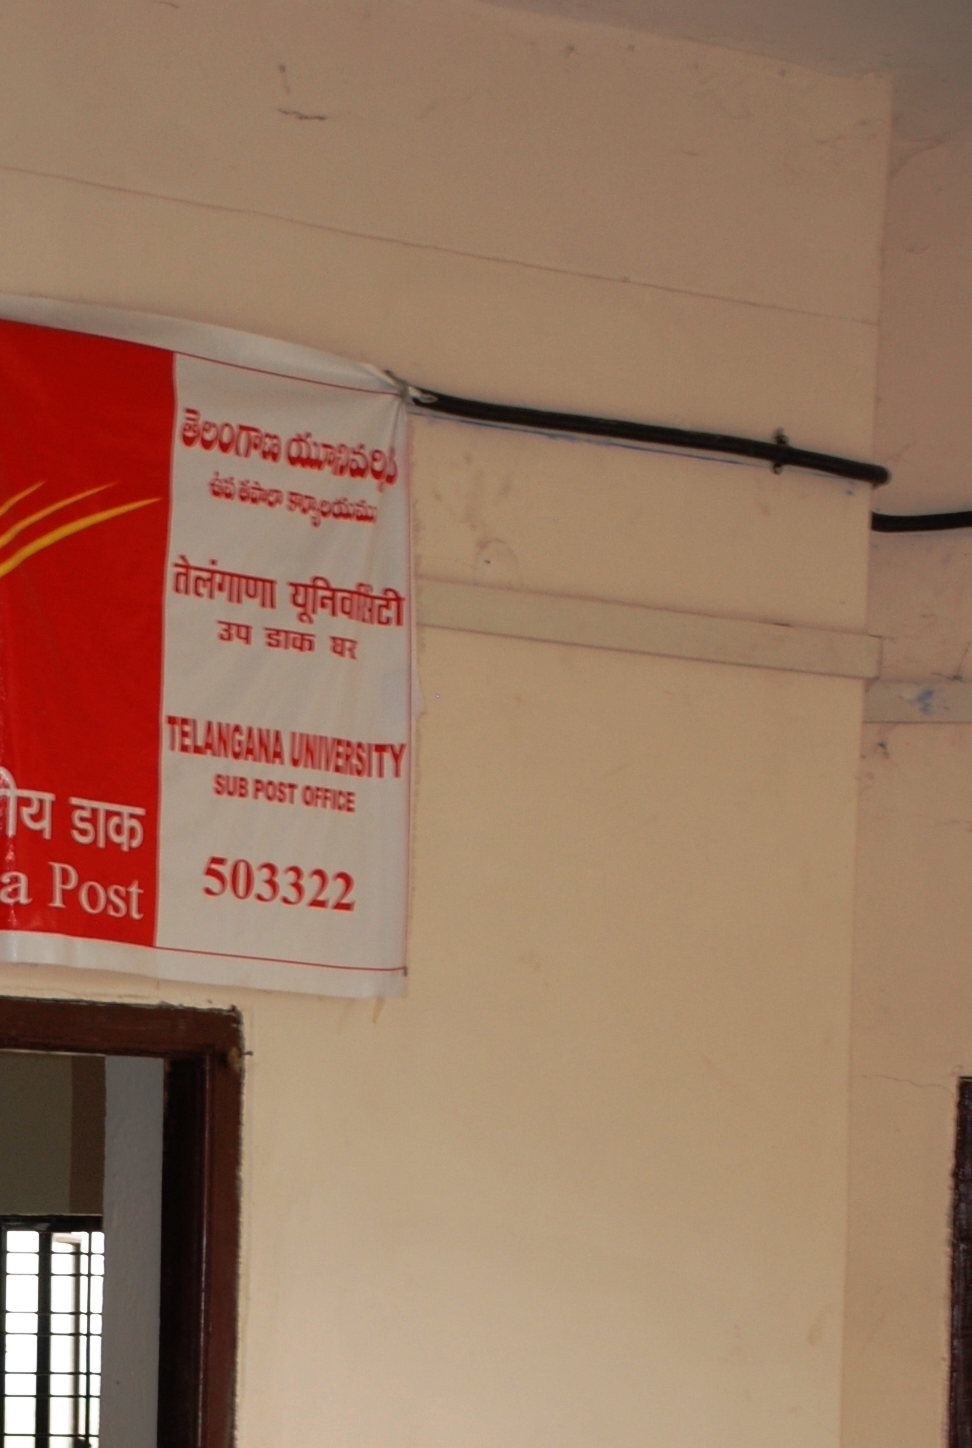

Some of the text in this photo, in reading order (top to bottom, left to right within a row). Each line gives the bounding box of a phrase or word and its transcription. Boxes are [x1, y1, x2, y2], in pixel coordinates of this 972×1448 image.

[217, 620, 359, 660] उप डाक घर
[166, 715, 406, 778] TELANGANA UNIVERSITY
[213, 773, 356, 813] SUB POST OFFICE
[70, 796, 146, 851] डाक
[48, 861, 144, 920] Post
[202, 856, 356, 912] 503322
